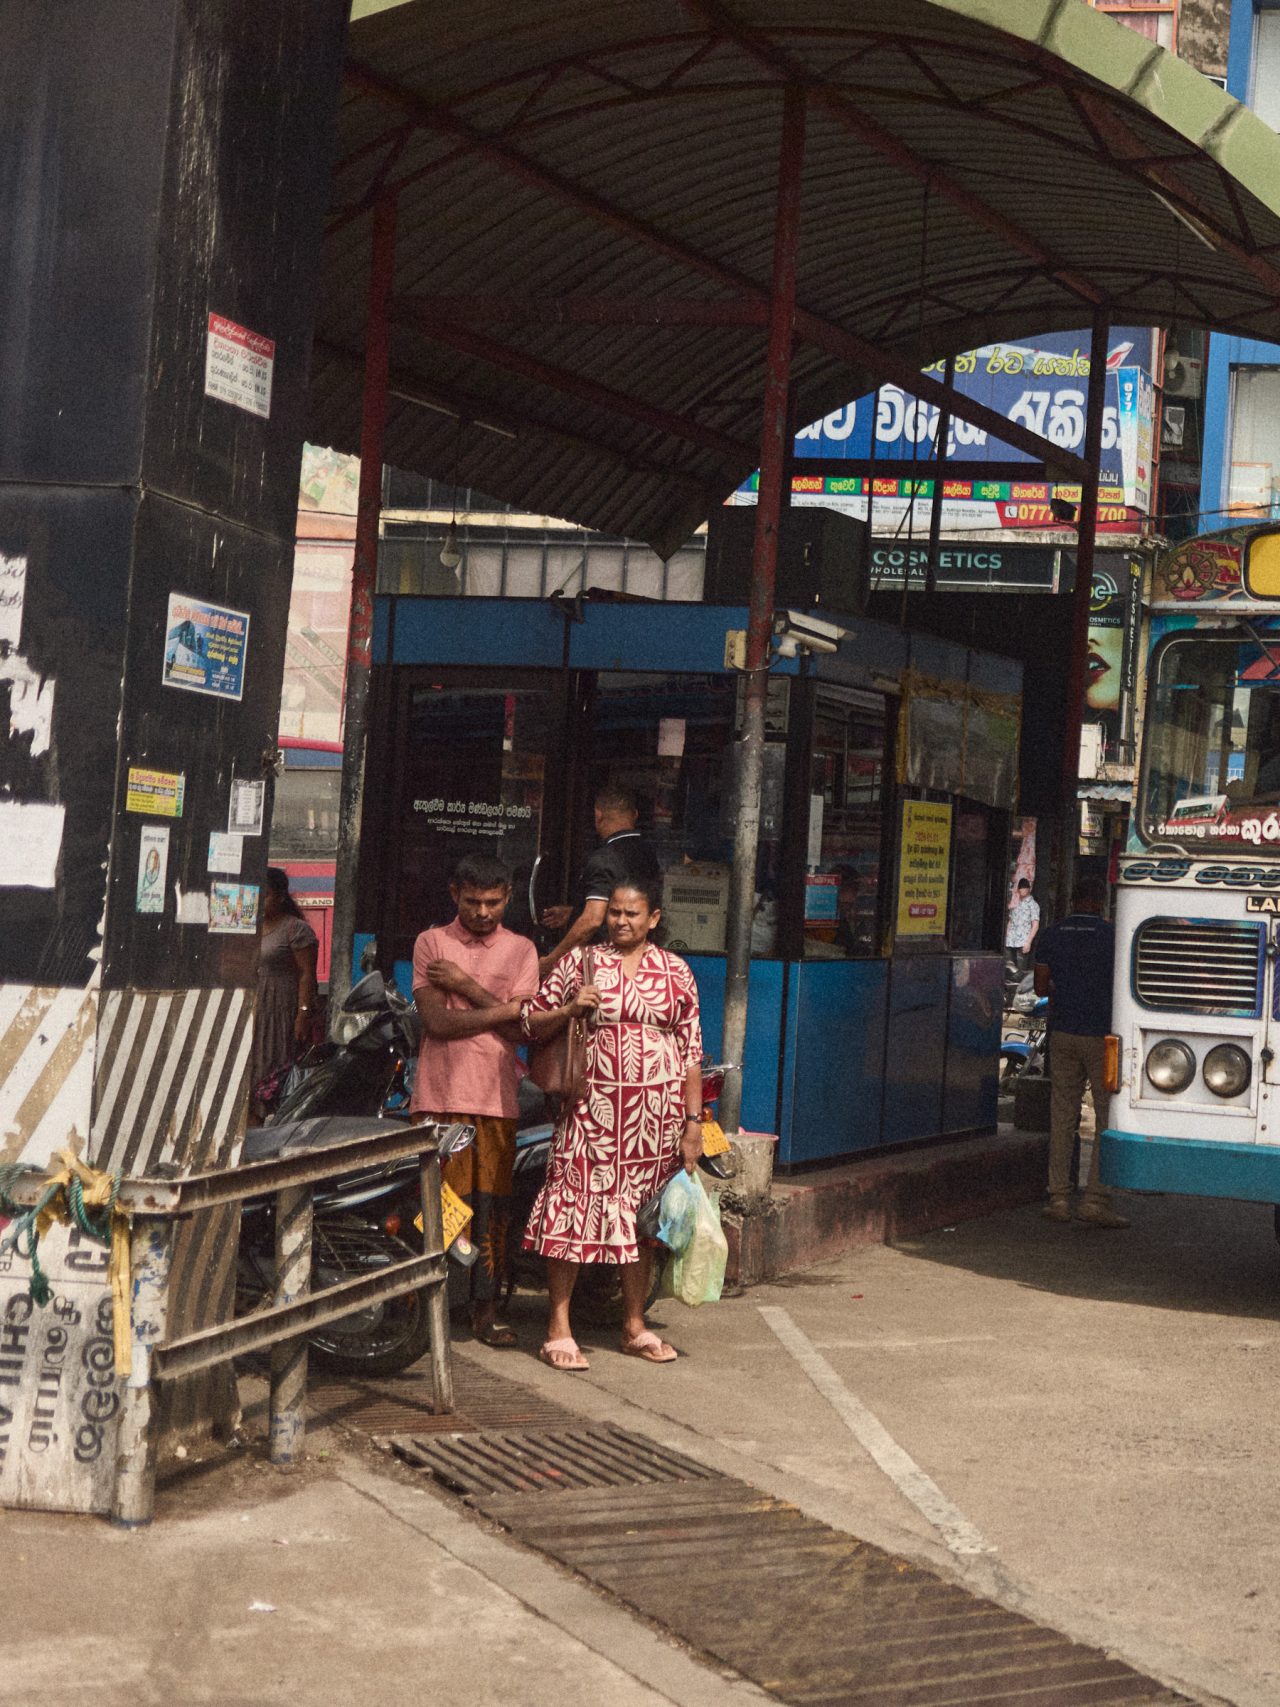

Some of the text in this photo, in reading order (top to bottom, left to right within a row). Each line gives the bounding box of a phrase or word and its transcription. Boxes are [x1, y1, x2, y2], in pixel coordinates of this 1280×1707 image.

[1088, 616, 1121, 625] OSMETICS
[1127, 578, 1138, 688] COSMETICS
[299, 898, 333, 906] YLAND
